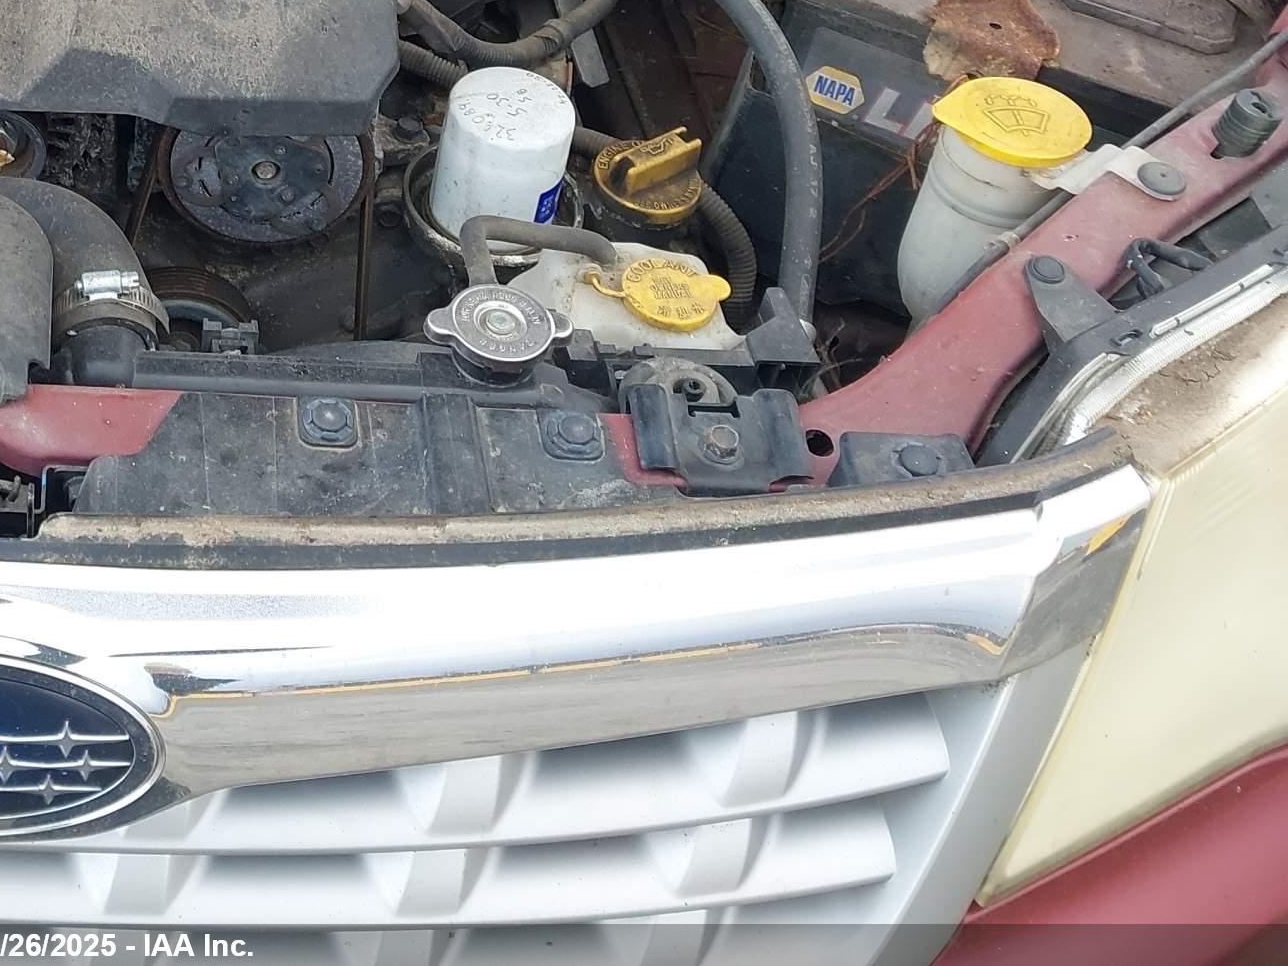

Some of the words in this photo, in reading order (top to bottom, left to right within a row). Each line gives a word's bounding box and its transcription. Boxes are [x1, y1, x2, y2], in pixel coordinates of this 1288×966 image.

[813, 75, 855, 106] NAPA
[598, 141, 629, 169] ENGINE
[626, 260, 696, 282] COOLANT
